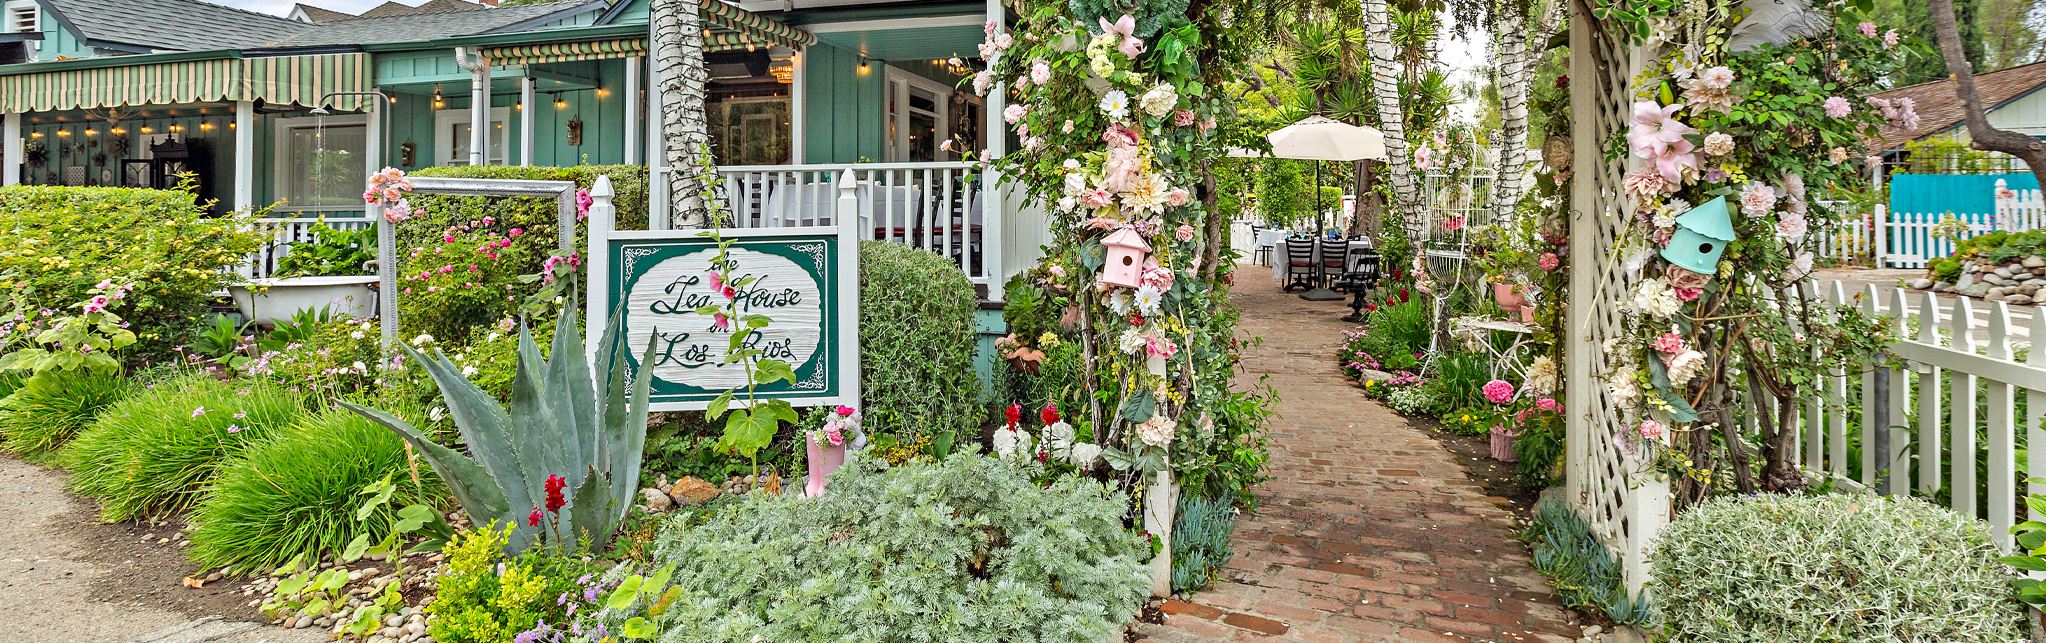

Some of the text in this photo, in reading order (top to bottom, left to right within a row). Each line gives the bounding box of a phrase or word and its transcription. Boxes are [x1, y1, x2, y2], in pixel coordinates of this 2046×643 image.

[650, 274, 802, 315] Tea House
[655, 328, 797, 368] Los Rios
